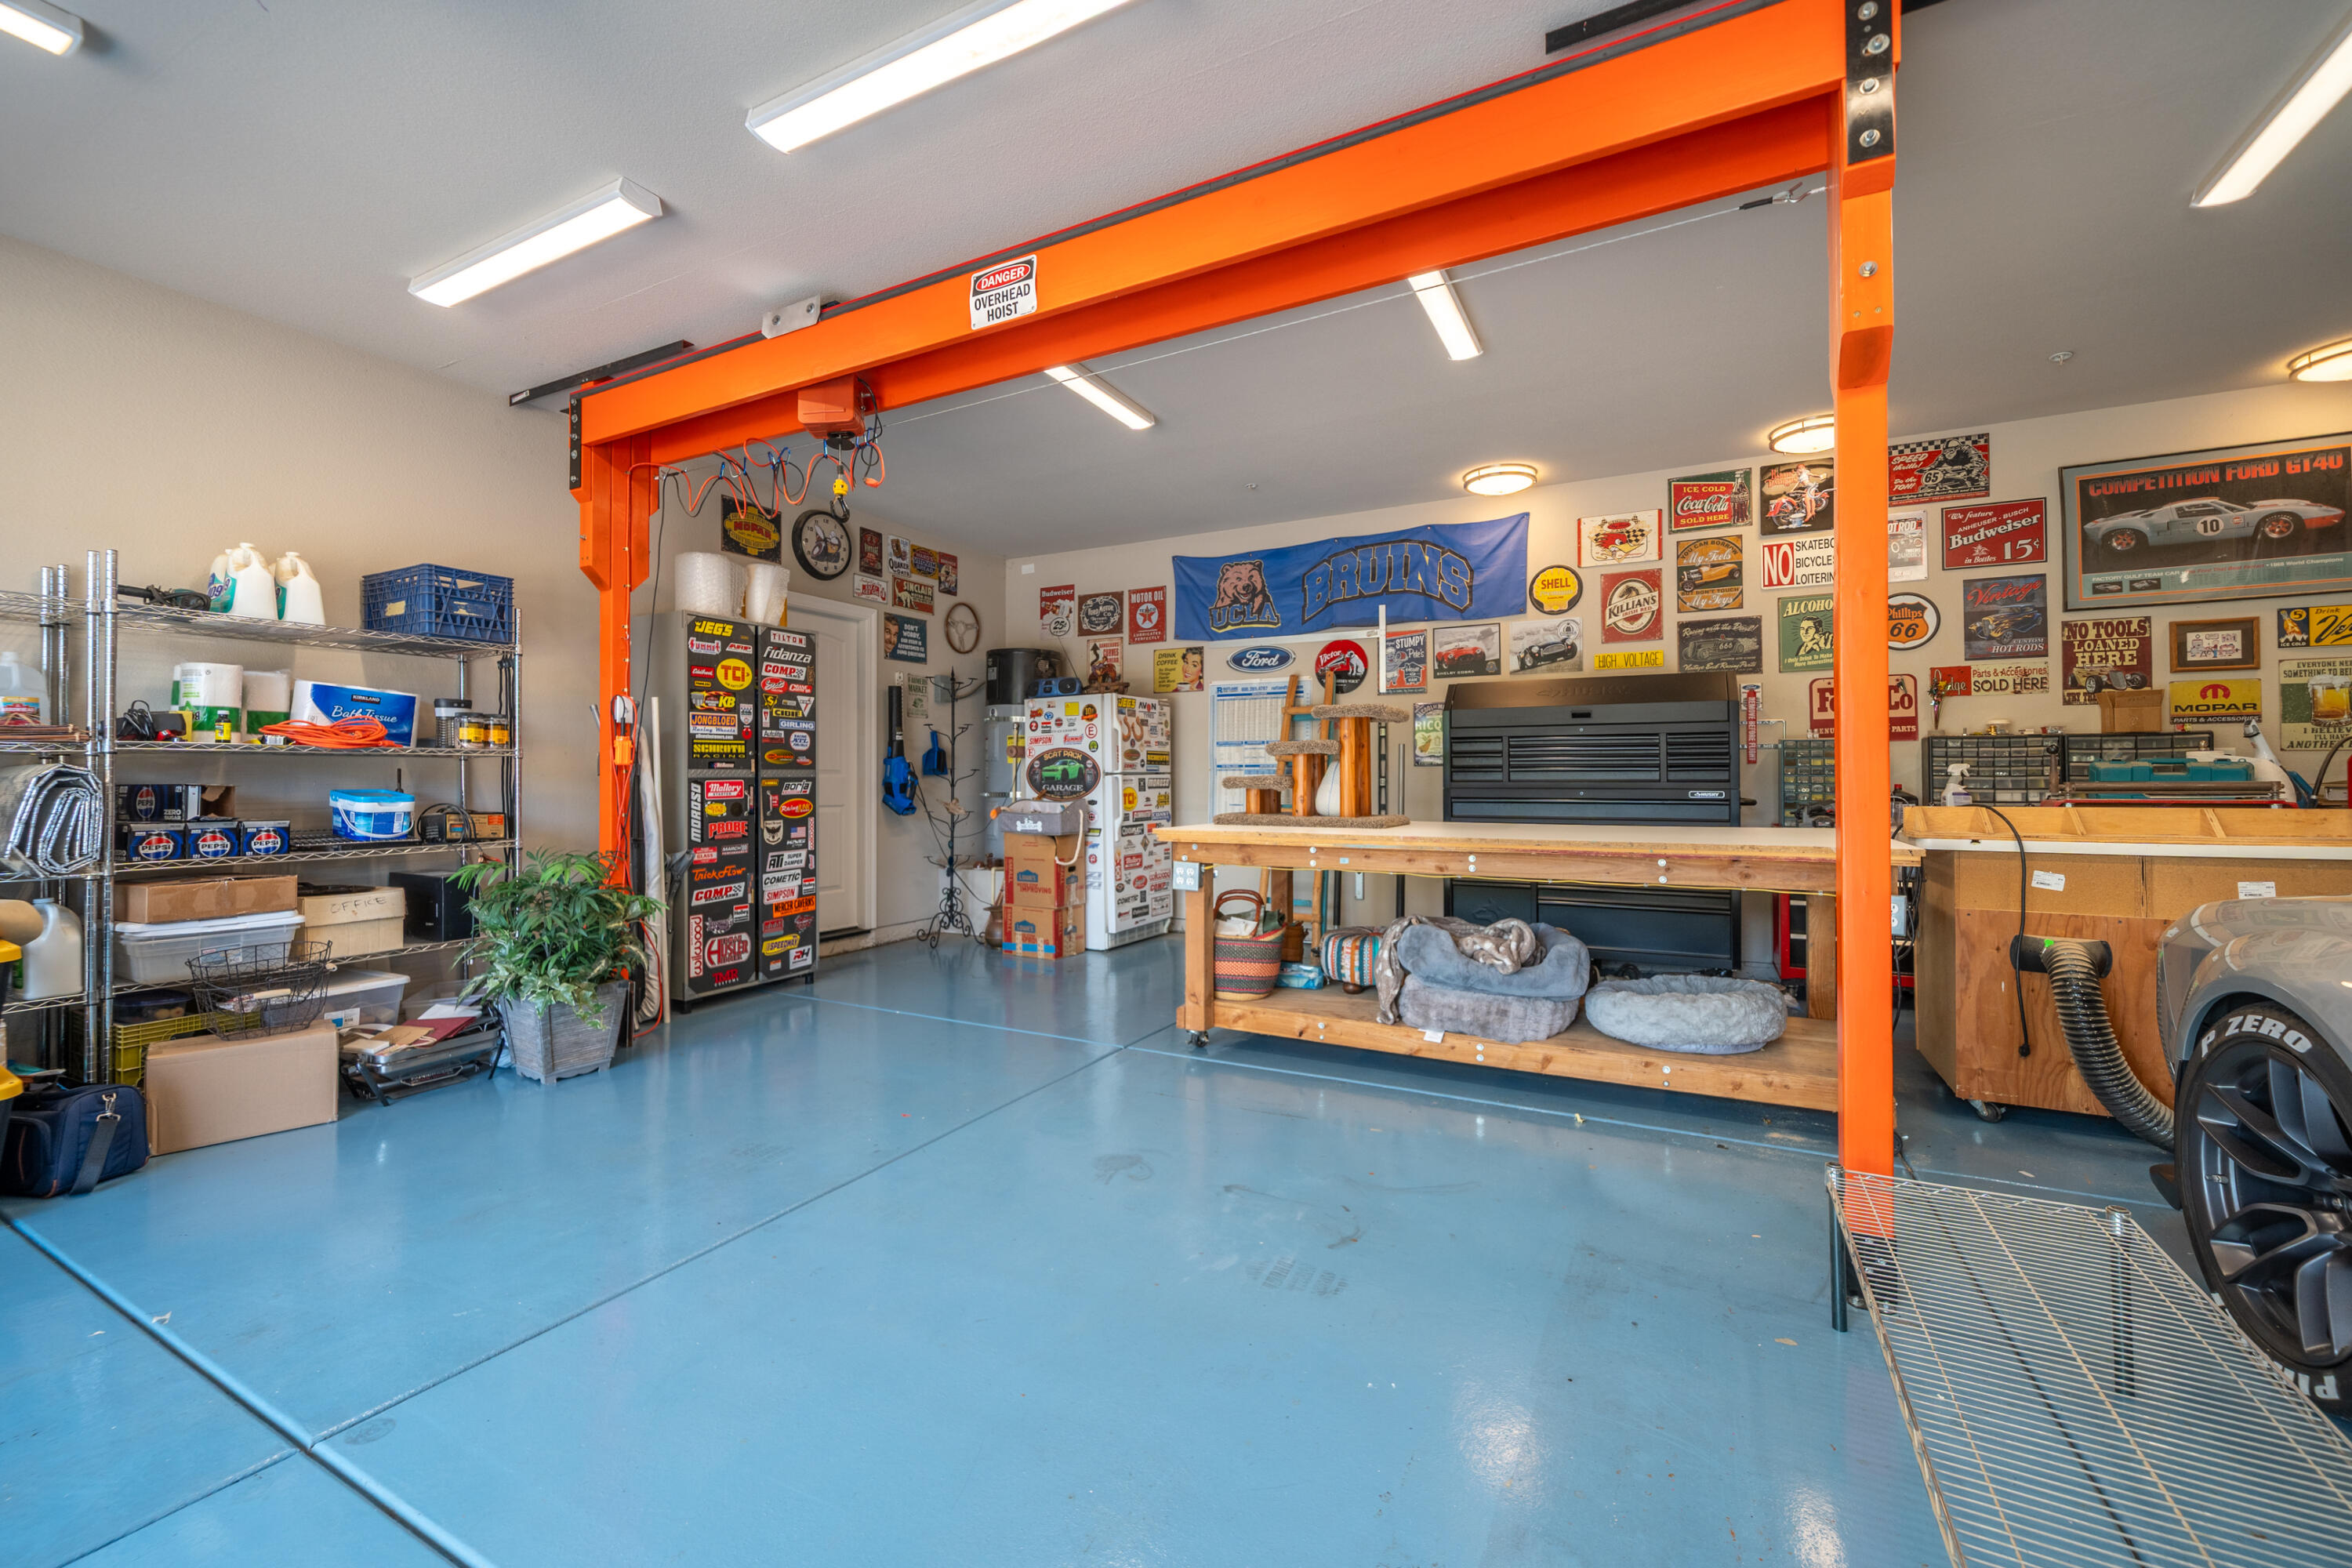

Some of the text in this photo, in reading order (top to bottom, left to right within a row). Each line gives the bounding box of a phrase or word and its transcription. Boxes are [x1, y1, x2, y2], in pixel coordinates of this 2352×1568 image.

[981, 267, 1025, 289] DANGER
[975, 284, 1030, 310] OVERHEAD
[987, 301, 1018, 321] HOIST
[1891, 454, 1928, 465] SPEED
[1925, 472, 1939, 483] 65
[2089, 452, 2343, 496] COMPETITION FORD GT40
[1677, 495, 1731, 515] Coca-Cola
[1958, 508, 2029, 532] ANHEUSER BUSCH
[1962, 510, 1994, 522] feature
[734, 521, 771, 539] MOPAR
[1899, 521, 1916, 532] ROD
[1949, 514, 2041, 550] Budweiser
[2201, 519, 2220, 534] 10
[1681, 539, 1738, 560] YOU CAN BORROW
[889, 558, 909, 572] QUAKER
[1683, 550, 1731, 565] My Tools
[1764, 544, 1793, 586] NO
[1973, 555, 1996, 564] Bottles
[1303, 541, 1472, 622] BRUINS
[1541, 578, 1570, 590] SHELL
[1795, 572, 1835, 585] LOITERIN
[903, 581, 932, 596] SINCLAIR
[1041, 589, 1073, 597] Budweiser
[1967, 579, 2043, 608] Vintage
[1131, 590, 1163, 604] MOTOR OIL
[1686, 595, 1707, 608] My
[1211, 601, 1278, 627] UCLA
[1608, 595, 1657, 619] KILLIAN'S
[1783, 599, 1834, 618] ALCOHO
[1888, 607, 1922, 620] Phillips
[695, 621, 733, 637] JEG'S
[1890, 622, 1919, 637] 66
[2067, 619, 2147, 640] NO TOOLS
[772, 633, 803, 644] TILTON
[1396, 635, 1425, 649] STUMPY
[2073, 638, 2140, 652] LOANED
[764, 646, 812, 663] fidanza
[1406, 648, 1425, 659] Pete's
[1991, 643, 2045, 653] HOT RODS
[1242, 650, 1279, 666] Ford
[1319, 650, 1342, 666] Victor
[1599, 652, 1661, 668] HIGH VOLTAGE
[2076, 651, 2137, 667] HERE
[721, 665, 745, 682] TCI
[764, 664, 796, 675] COMP
[1973, 669, 1991, 678] Parts
[2001, 667, 2047, 677] Accessories
[2284, 668, 2325, 677] SOMETHING
[909, 684, 927, 694] MARKET
[1973, 677, 2048, 691] SOLD HERE
[718, 696, 735, 708] KB
[2067, 691, 2081, 702] TRY
[332, 706, 397, 723] Bath Tissue
[1138, 702, 1156, 712] AVON
[2175, 702, 2257, 713] MOPAR
[691, 715, 735, 725] JONGBLOED
[1044, 750, 1082, 760] SCAT PACK
[709, 783, 742, 792] Mallory
[691, 782, 701, 843] MOROSO
[709, 821, 748, 839] PROBE
[769, 854, 783, 869] ATI
[764, 871, 800, 885] COMETIC
[695, 886, 732, 902] COMP
[767, 888, 795, 902] SIMPSON
[329, 896, 387, 913] OFFICE
[775, 900, 793, 912] MERCER
[794, 896, 814, 909] CAVERNS
[770, 940, 797, 950] SPEEDWAY
[793, 948, 810, 960] RH
[712, 968, 738, 983] TMR
[2201, 1014, 2312, 1058] P ZERO
